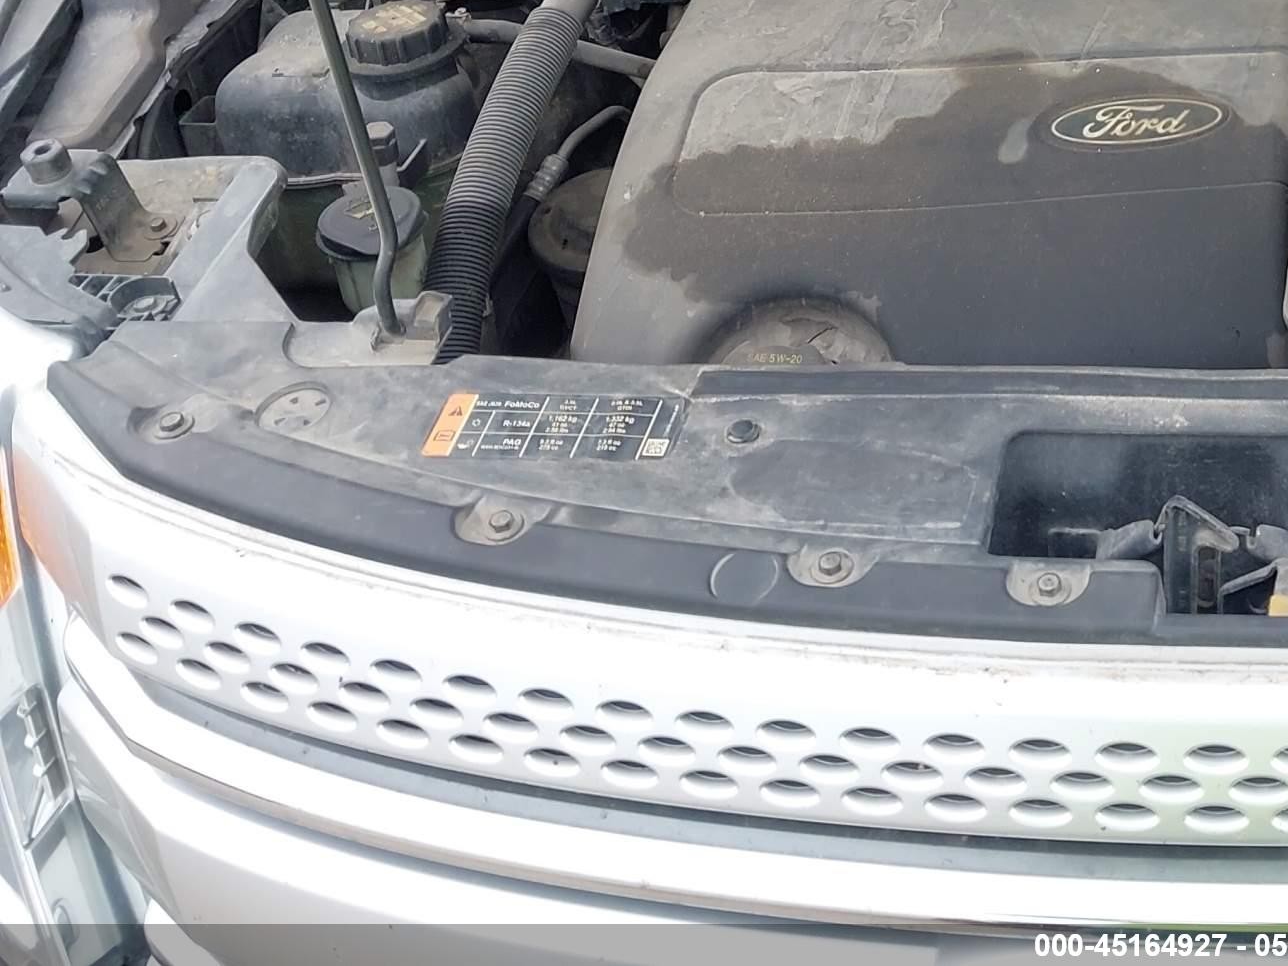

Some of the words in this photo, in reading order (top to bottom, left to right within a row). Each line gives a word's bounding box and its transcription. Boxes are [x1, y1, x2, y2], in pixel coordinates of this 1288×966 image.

[1082, 104, 1190, 139] Ford
[769, 353, 803, 364] 5W-20
[504, 400, 540, 409] FoMoCo
[503, 420, 531, 428] R-134a
